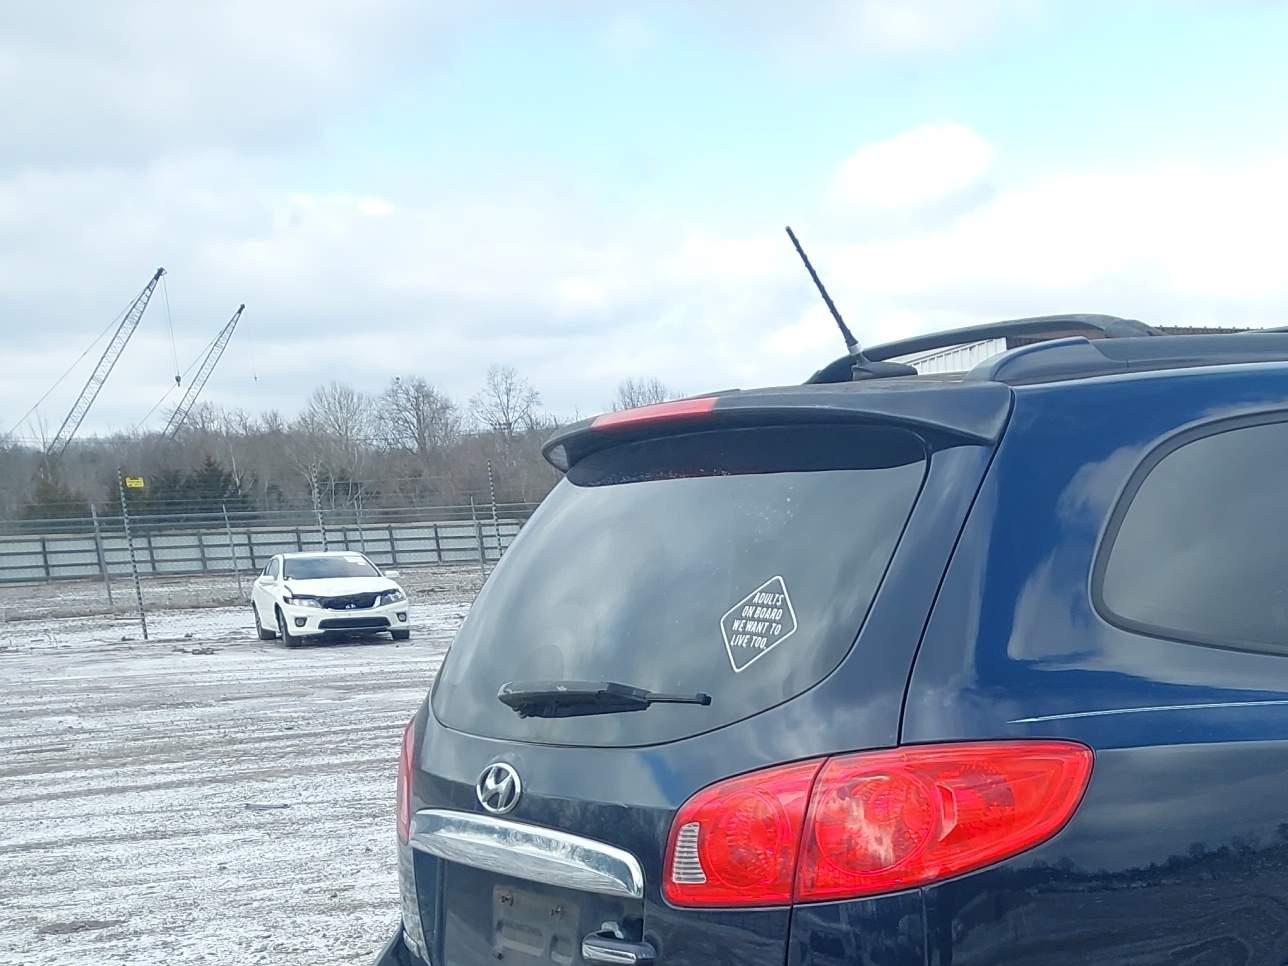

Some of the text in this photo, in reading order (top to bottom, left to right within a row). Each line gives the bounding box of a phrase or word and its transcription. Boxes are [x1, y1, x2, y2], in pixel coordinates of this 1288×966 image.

[752, 592, 784, 606] ADULTS
[742, 605, 783, 620] ON BOARD
[732, 618, 782, 636] WE WANT TO
[730, 634, 750, 648] LIVE
